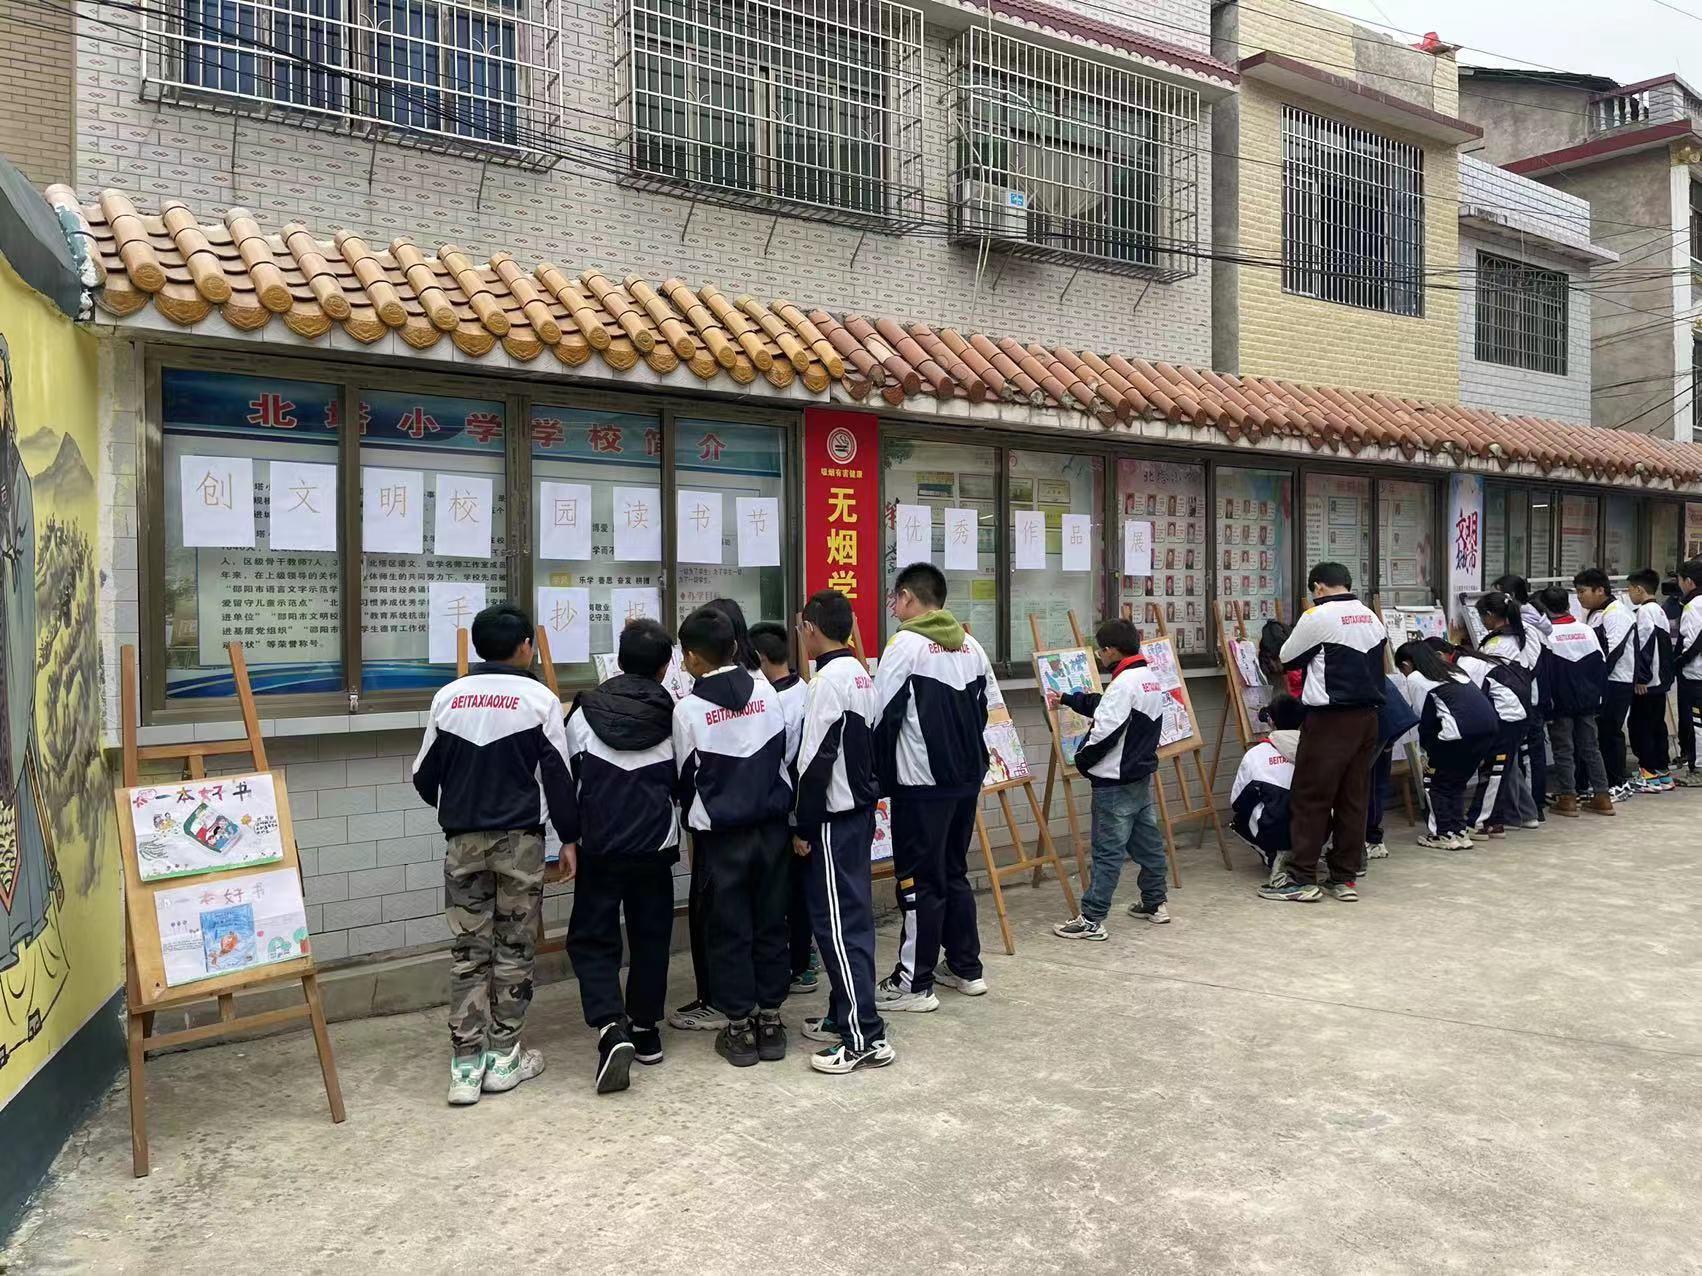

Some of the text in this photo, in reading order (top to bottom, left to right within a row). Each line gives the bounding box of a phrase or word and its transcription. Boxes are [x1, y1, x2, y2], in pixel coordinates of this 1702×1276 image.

[195, 470, 768, 537] 创 文 明 校 园 读 书 节
[904, 515, 923, 546] 优
[952, 519, 970, 545] 秀
[1023, 520, 1040, 545] 作
[1070, 525, 1083, 545] 品
[1128, 531, 1145, 553] 展
[441, 596, 473, 629] 手
[550, 600, 578, 632] 抄
[451, 694, 520, 710] BEITAXIAOXUE
